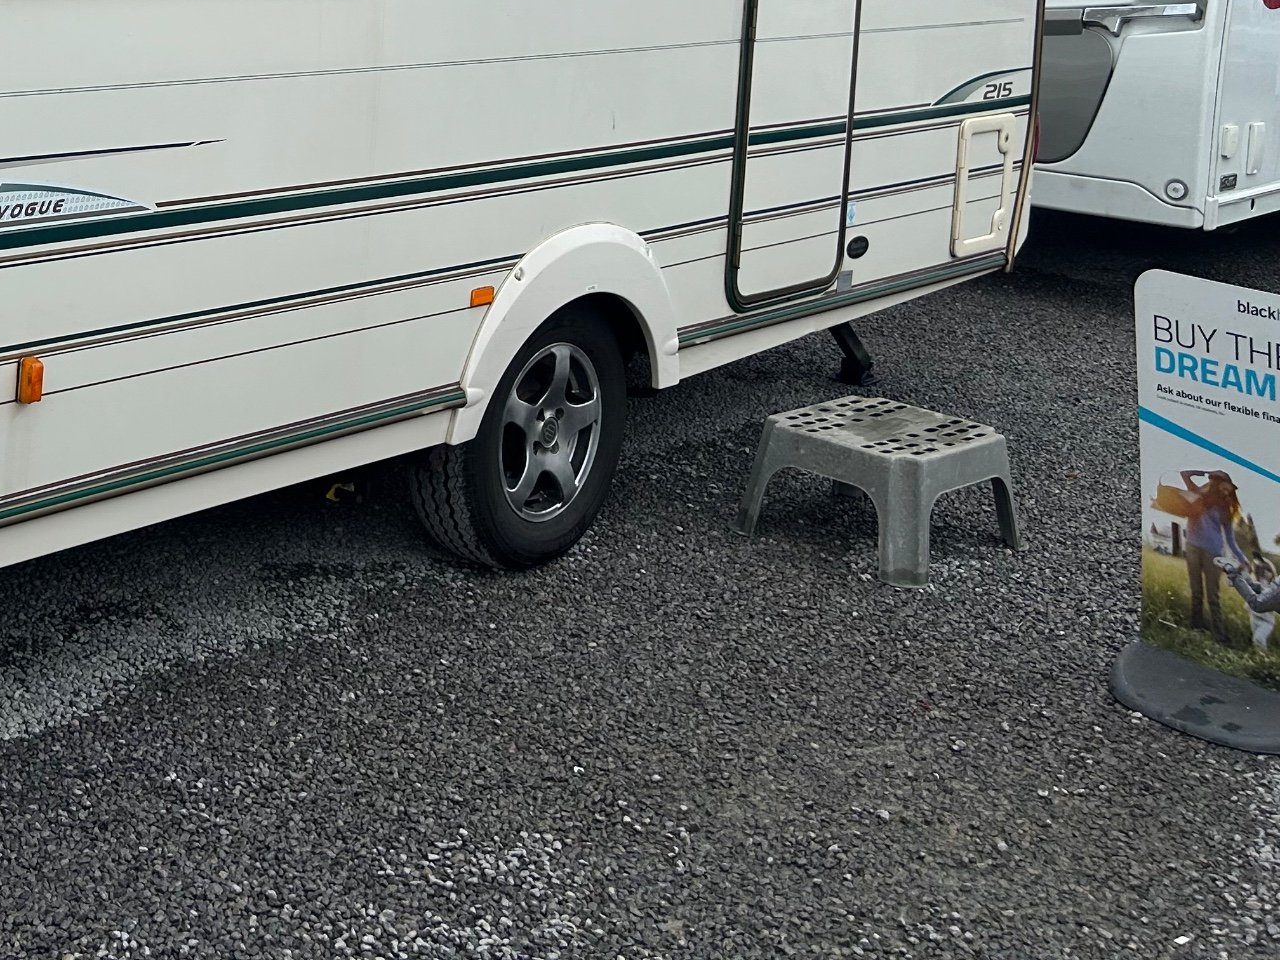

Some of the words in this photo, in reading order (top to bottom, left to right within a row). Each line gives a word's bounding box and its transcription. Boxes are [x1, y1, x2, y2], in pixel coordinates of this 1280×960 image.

[983, 82, 1013, 100] 215
[1153, 315, 1217, 353] BUY
[1154, 346, 1277, 401] DREAM
[1156, 383, 1174, 396] Ask
[1175, 390, 1203, 404] about
[1205, 398, 1222, 408] our
[1223, 401, 1260, 418] flexible
